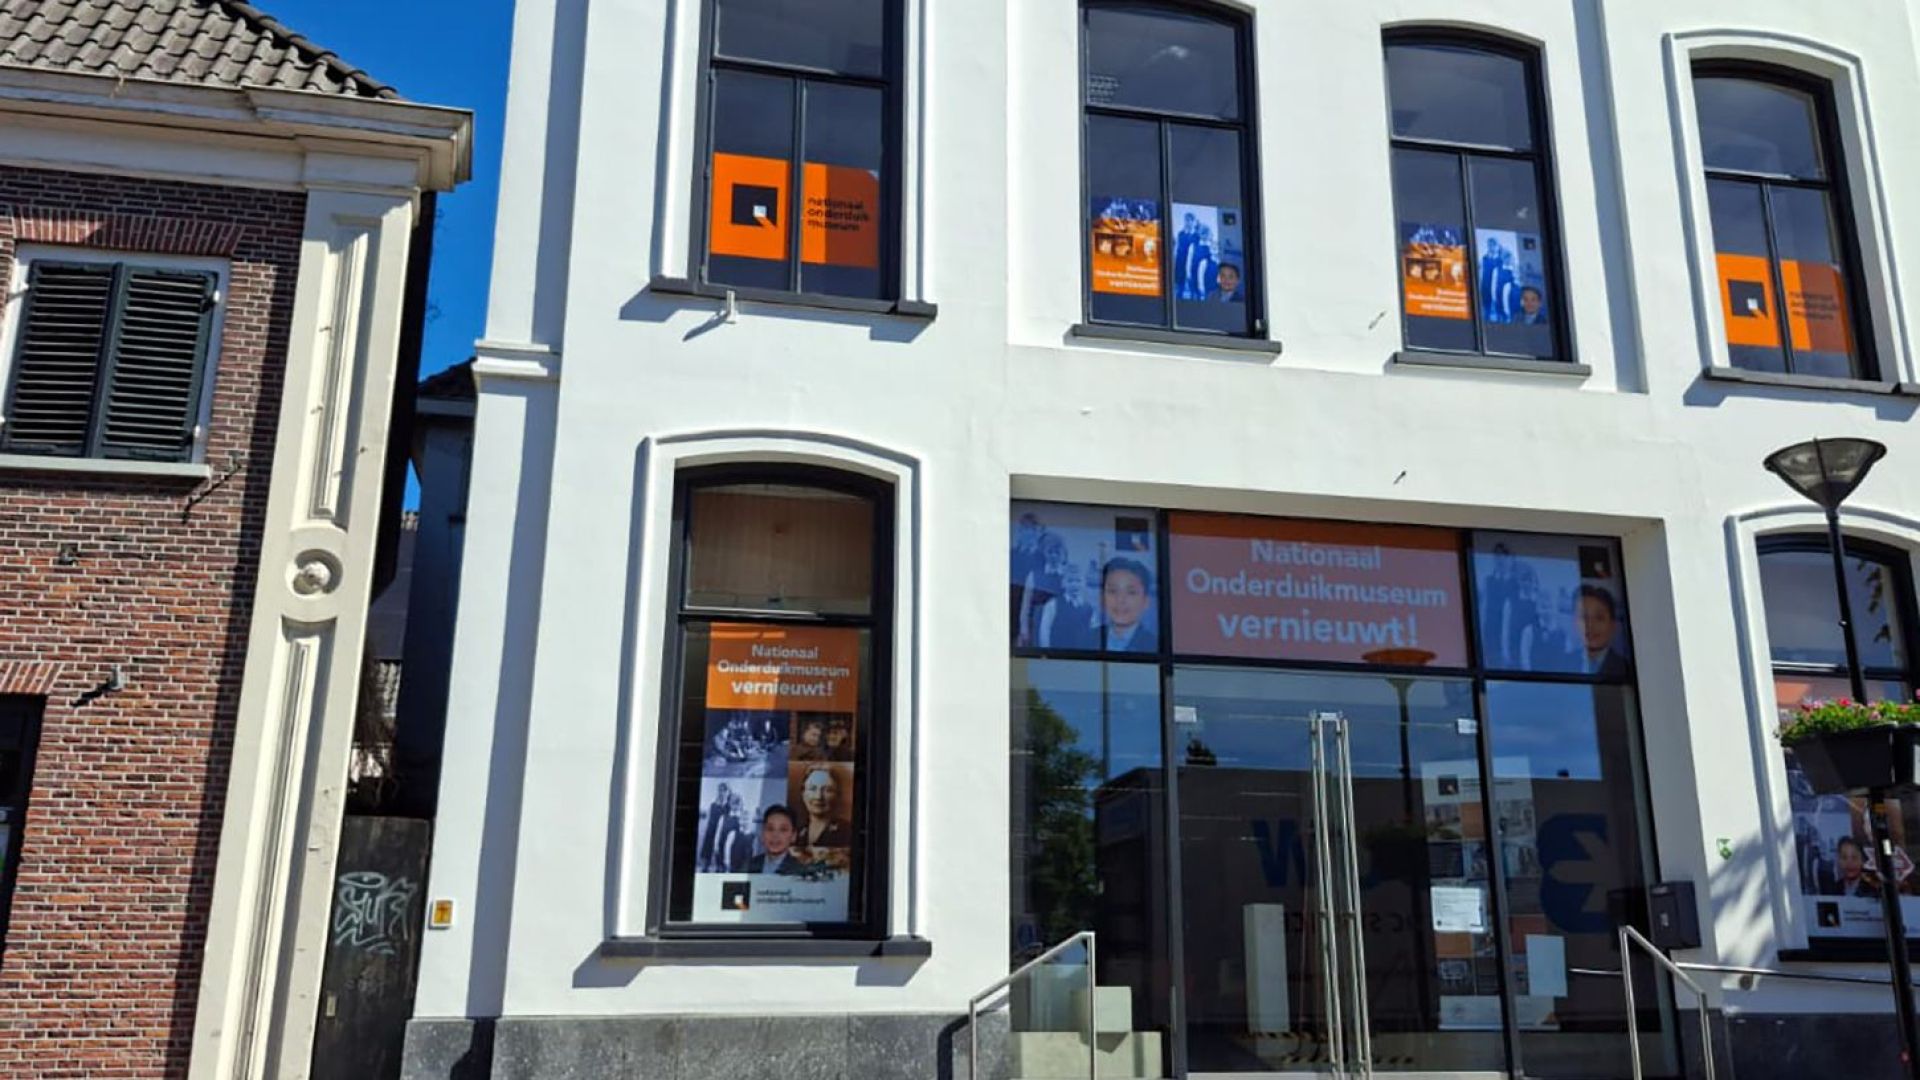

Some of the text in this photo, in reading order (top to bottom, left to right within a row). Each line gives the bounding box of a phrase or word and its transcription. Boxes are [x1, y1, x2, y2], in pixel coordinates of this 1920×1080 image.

[1251, 538, 1382, 570] Nationaal
[1186, 567, 1448, 607] Onderduikmuseum
[1217, 608, 1419, 647] vernieuwt!
[751, 644, 818, 659] Nationaal
[717, 659, 850, 678] Onderduikmuseum
[731, 678, 834, 697] vernieuwt!
